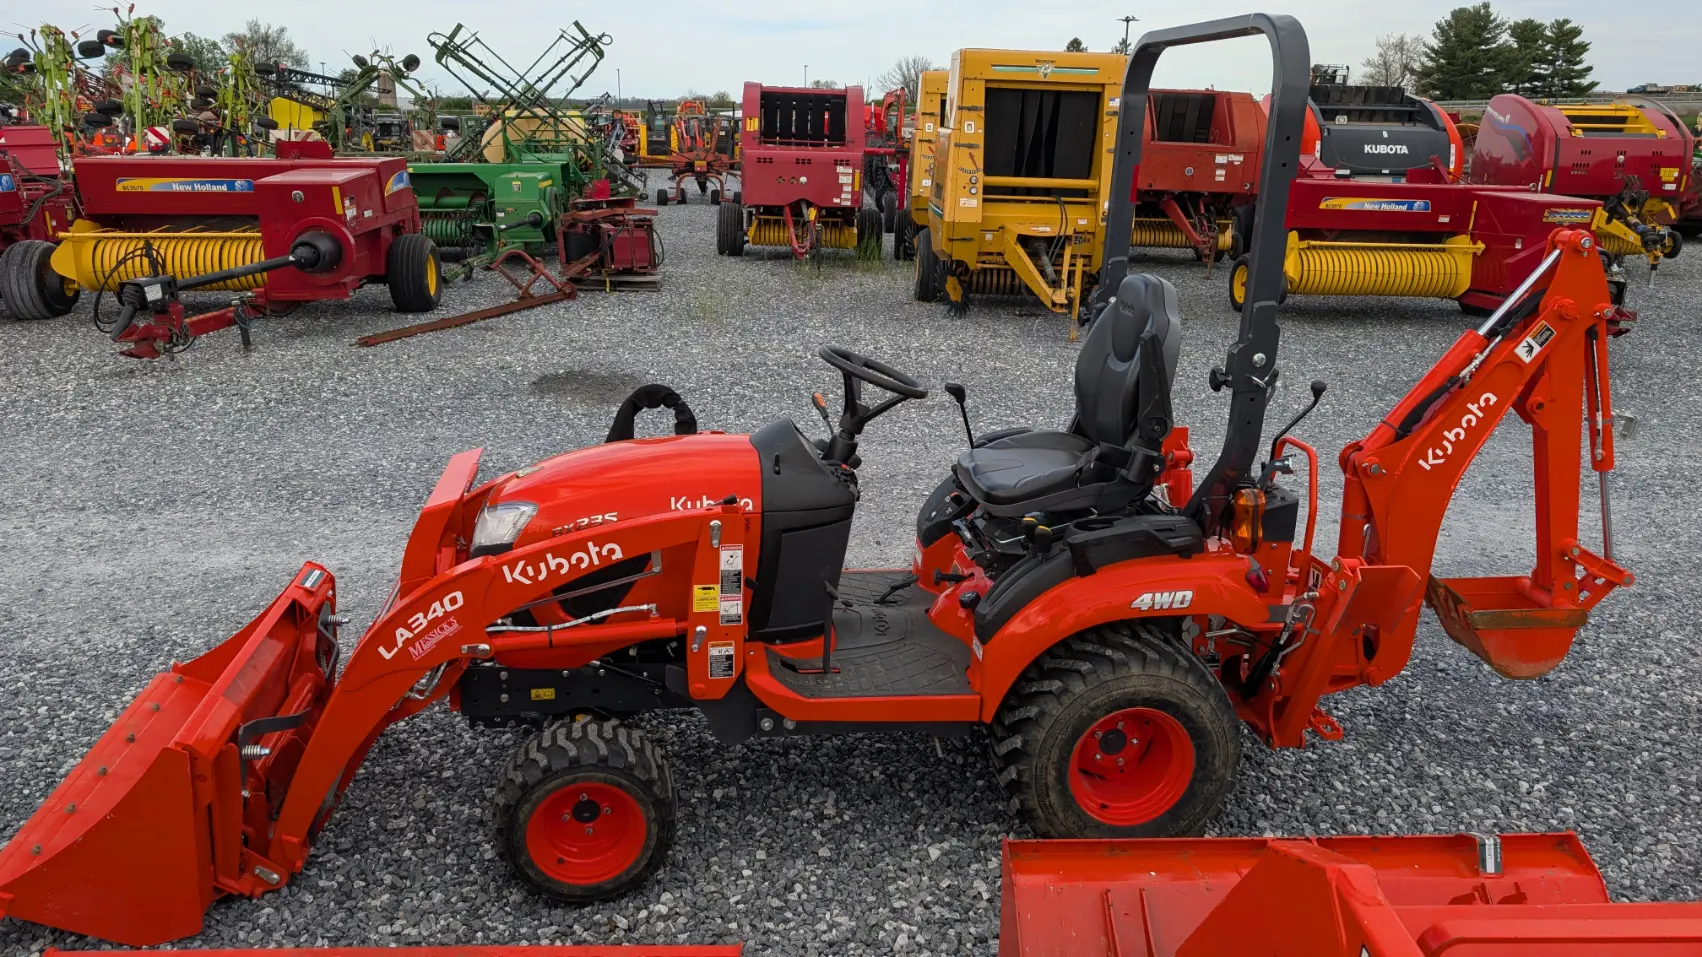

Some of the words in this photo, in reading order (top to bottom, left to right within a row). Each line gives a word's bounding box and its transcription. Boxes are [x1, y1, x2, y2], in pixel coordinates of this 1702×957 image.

[1364, 144, 1409, 154] KUBOTA
[172, 183, 192, 191] New
[194, 182, 227, 191] Holland
[1363, 202, 1380, 210] New
[1380, 203, 1408, 211] Holland
[1417, 392, 1498, 471] Kubota
[670, 495, 753, 511] Kuba
[502, 541, 623, 585] Kubota
[1130, 590, 1194, 611] 4WD
[377, 590, 464, 660] LA340
[407, 616, 458, 661] MESSICK'S
